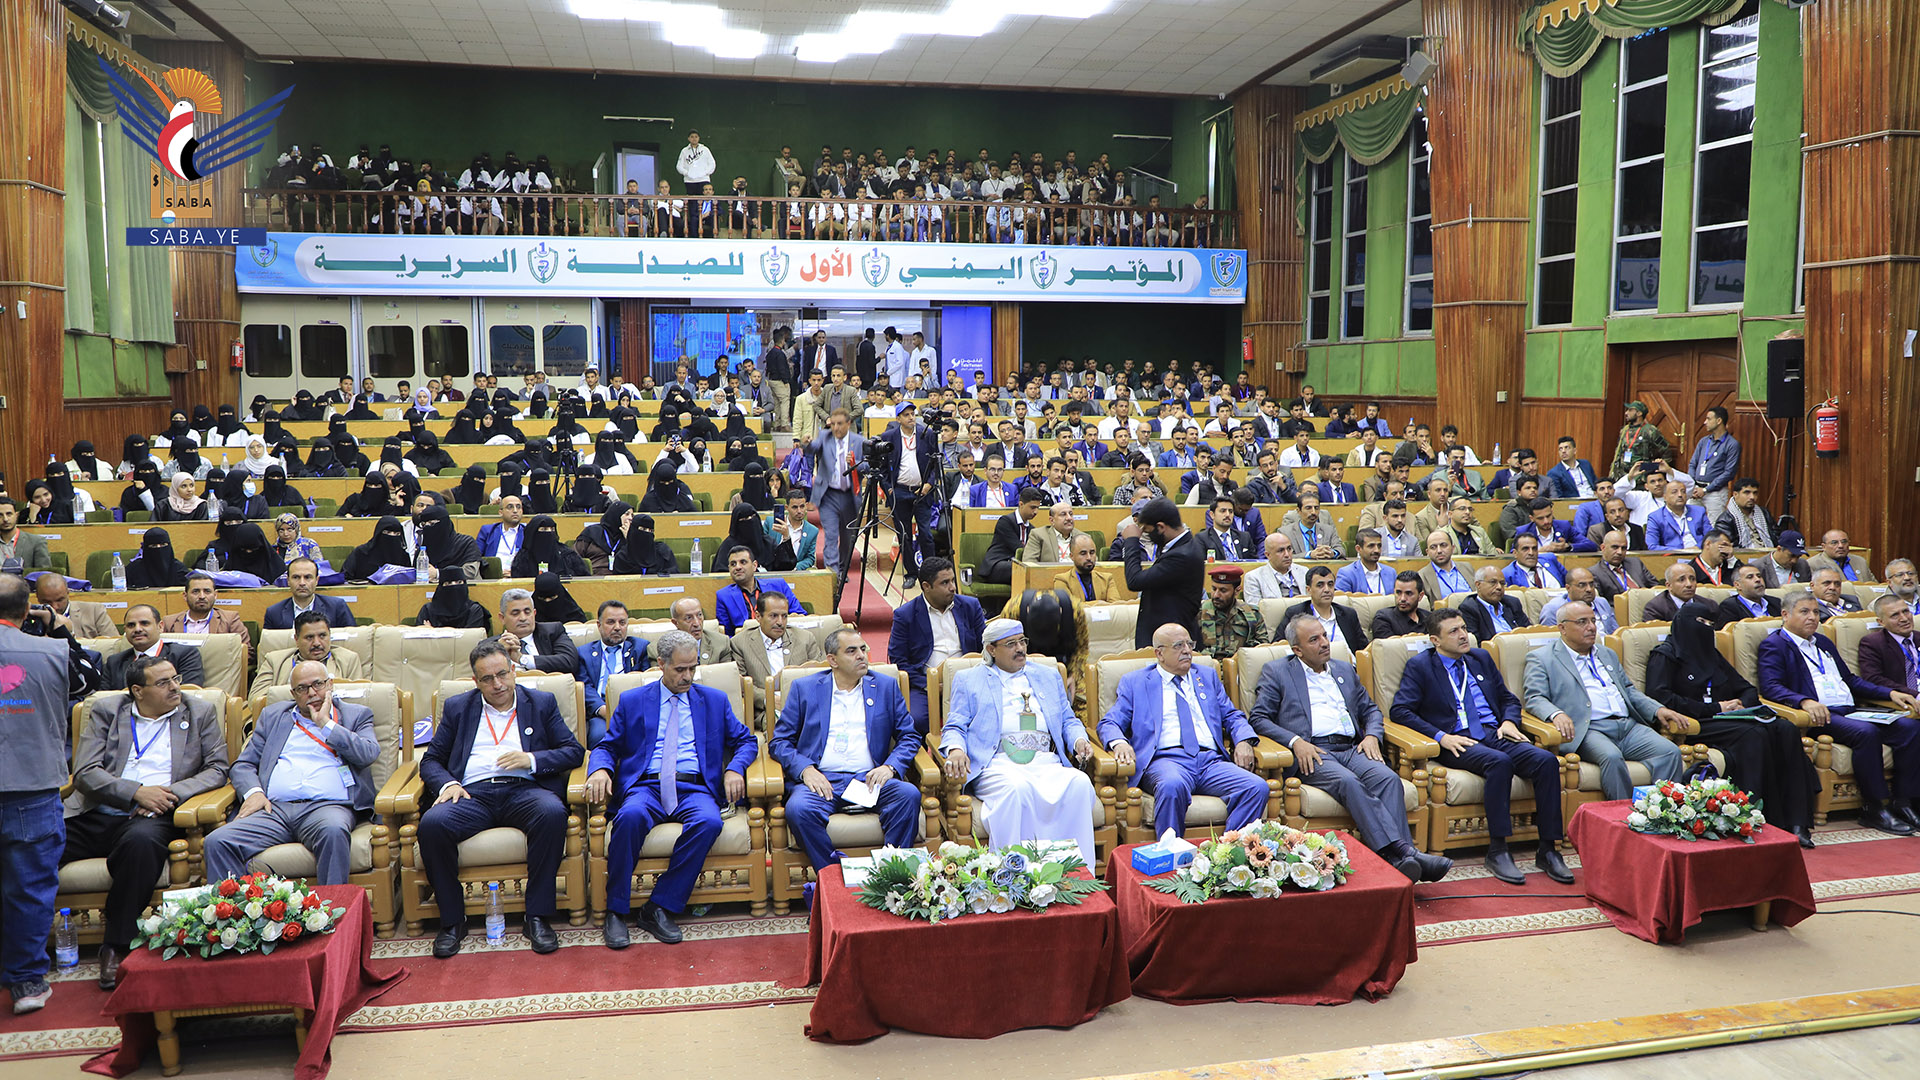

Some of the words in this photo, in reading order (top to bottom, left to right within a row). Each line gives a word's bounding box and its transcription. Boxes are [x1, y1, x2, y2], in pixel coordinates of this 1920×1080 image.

[538, 241, 548, 254] 1
[769, 245, 780, 258] 1
[870, 247, 882, 259] 1
[1039, 250, 1048, 262] 1
[314, 245, 517, 279] السريرية
[567, 248, 744, 281] للصيدلة
[799, 247, 853, 283] الأول
[899, 256, 1023, 288] اليمني
[1064, 259, 1184, 288] المؤتمر
[0, 698, 32, 706] ystems
